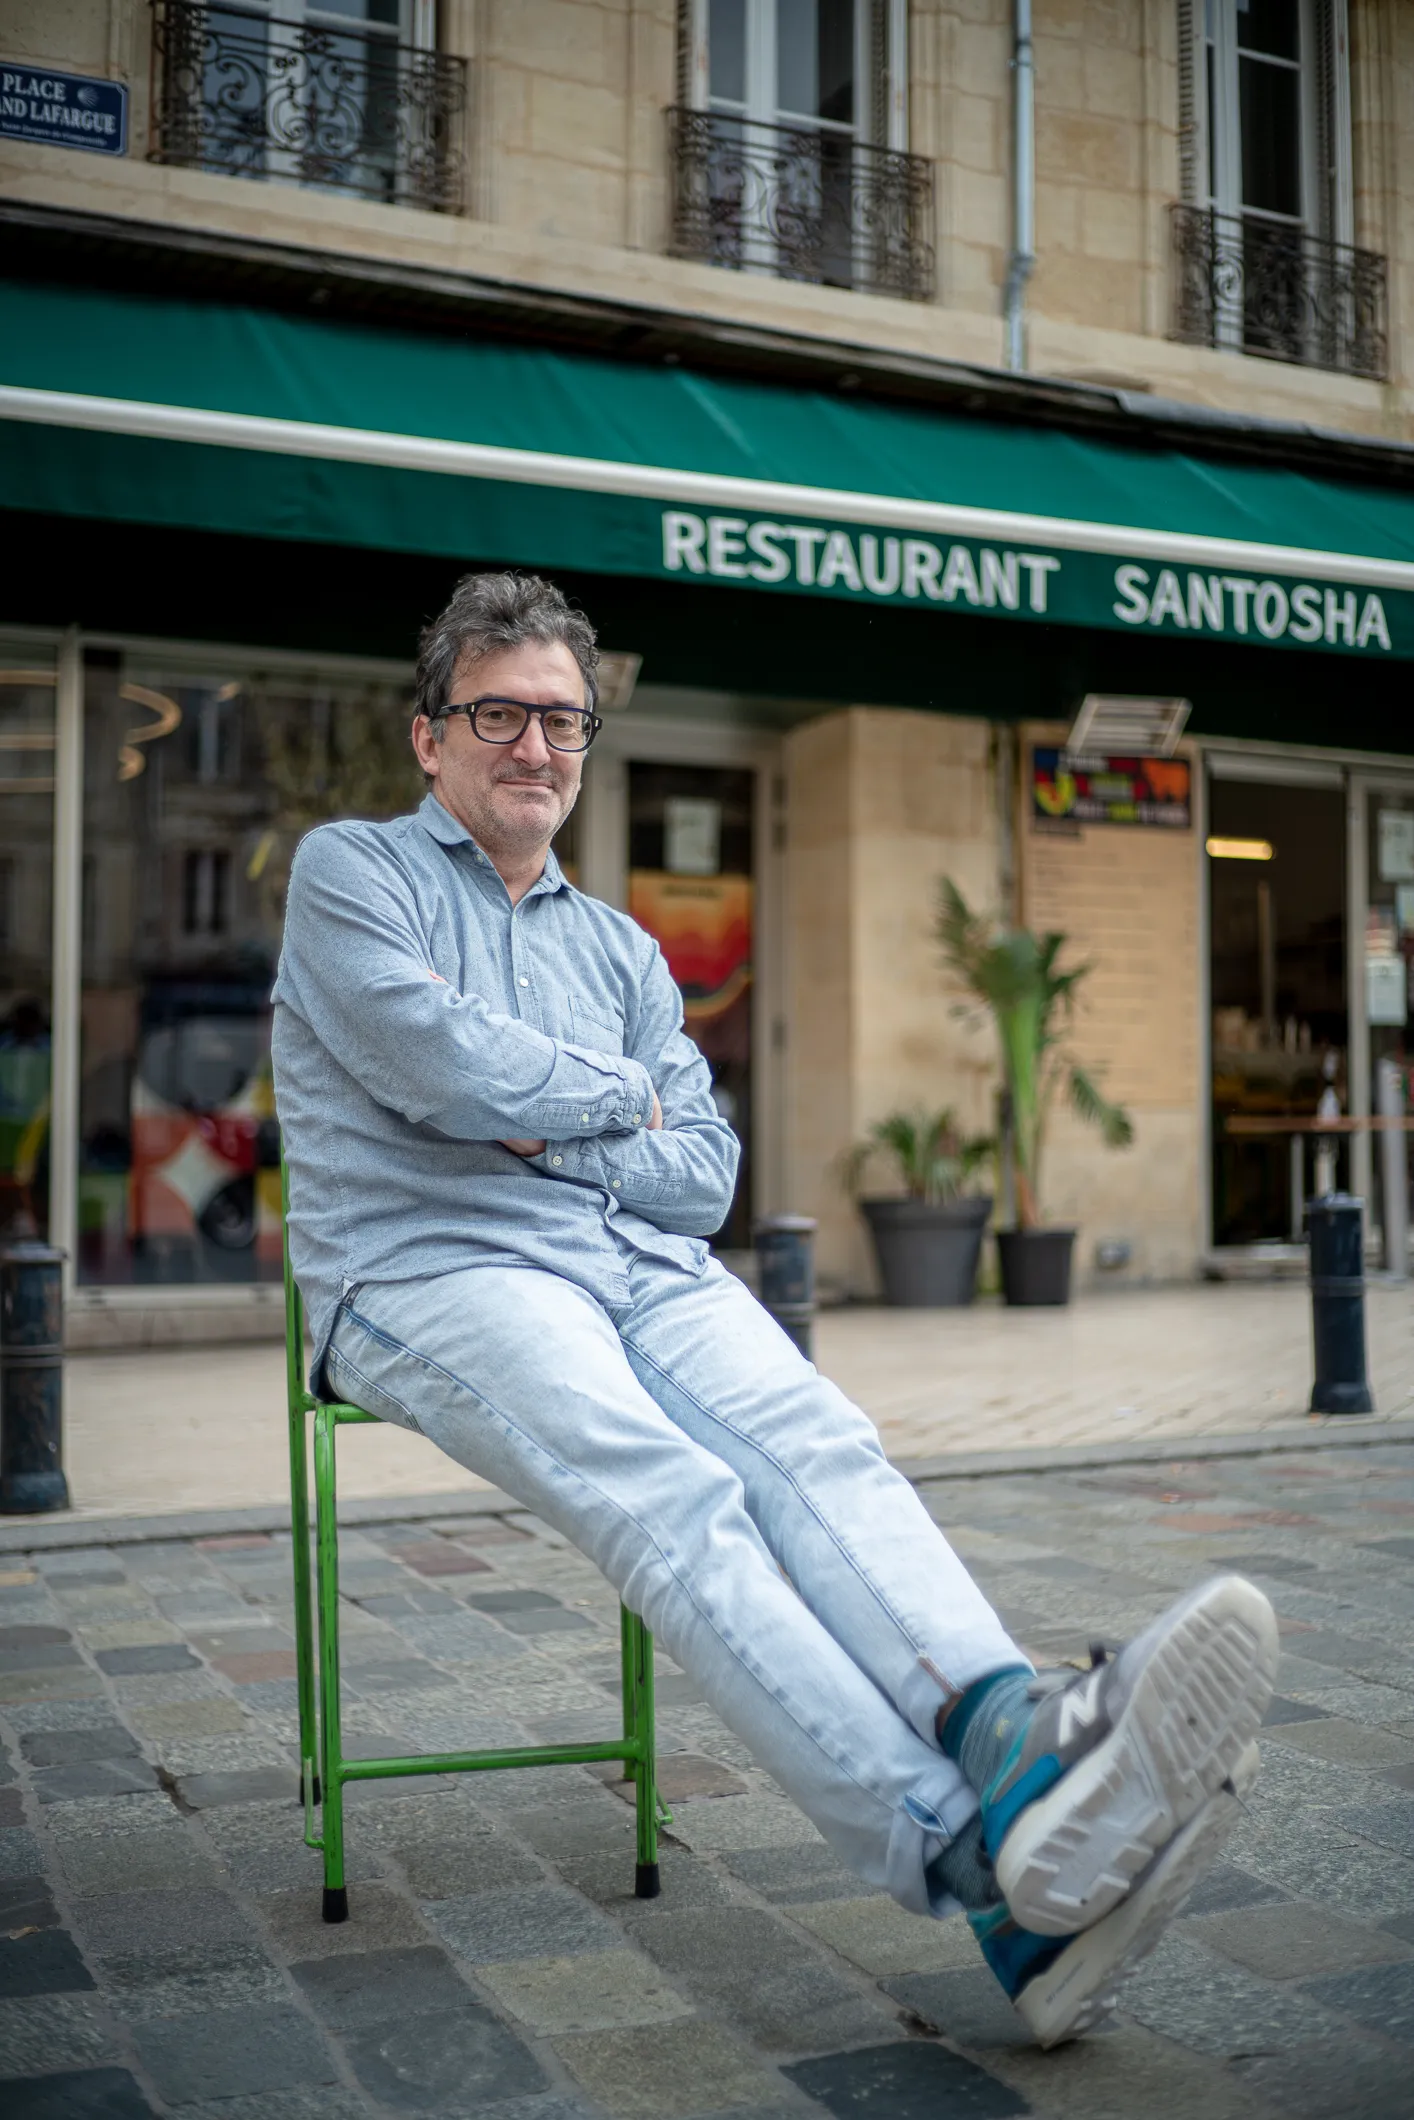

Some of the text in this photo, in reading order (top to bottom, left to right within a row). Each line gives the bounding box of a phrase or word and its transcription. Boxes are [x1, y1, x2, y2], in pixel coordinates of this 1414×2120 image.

[2, 73, 66, 102] PLACE
[0, 96, 28, 118] ND
[30, 101, 116, 135] LAFARGUE
[661, 510, 1392, 651] RESTAURANT SANTOSHA
